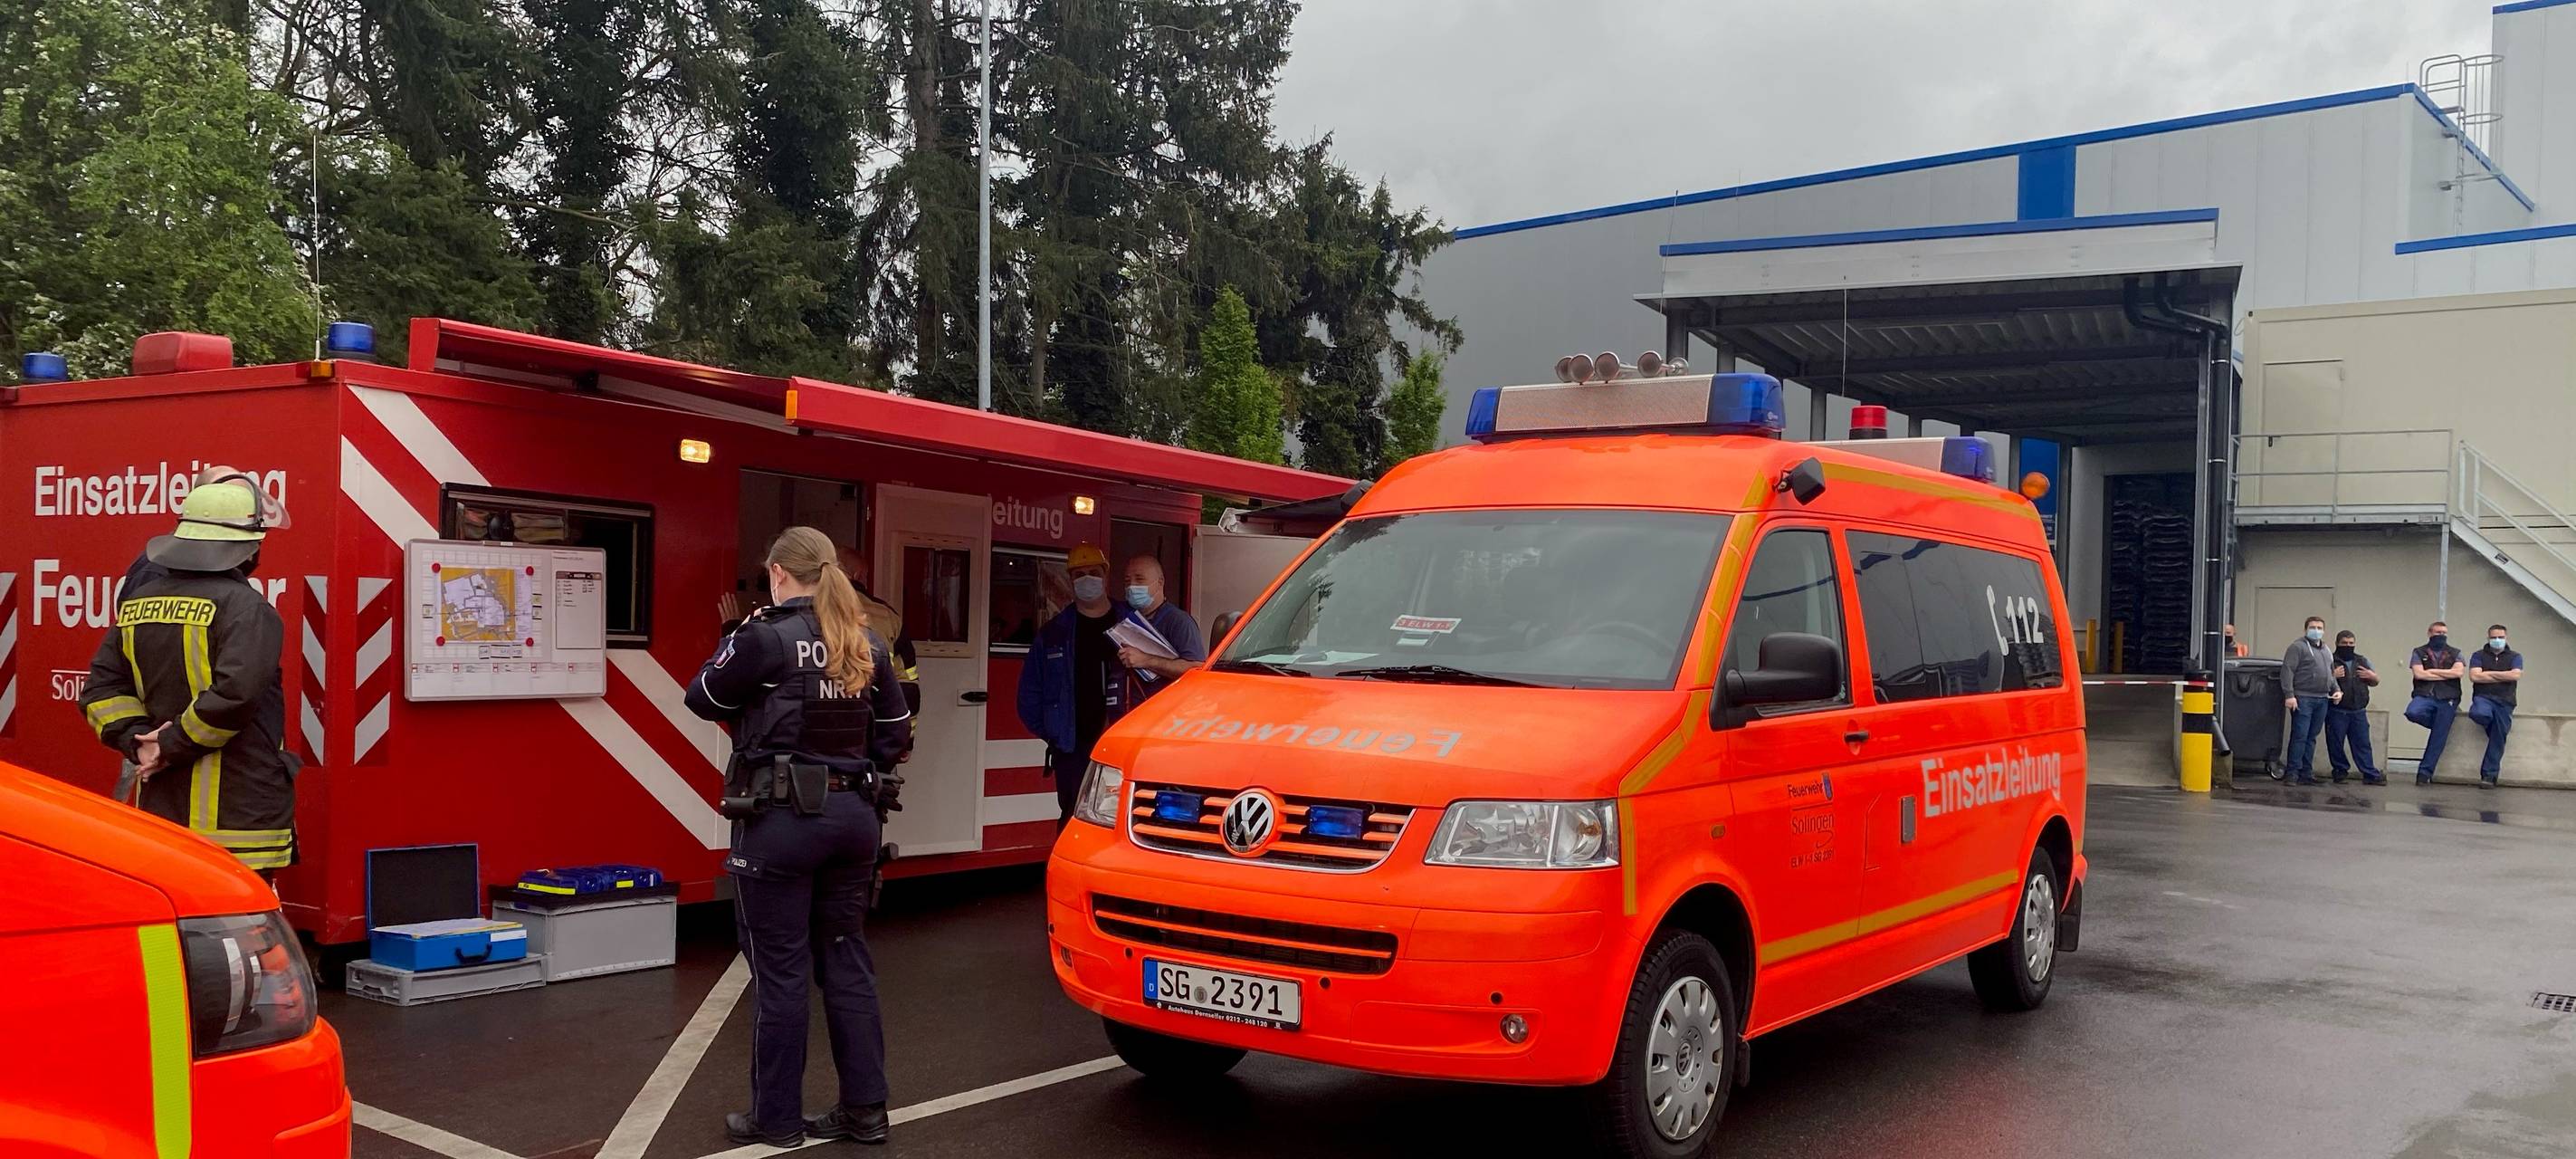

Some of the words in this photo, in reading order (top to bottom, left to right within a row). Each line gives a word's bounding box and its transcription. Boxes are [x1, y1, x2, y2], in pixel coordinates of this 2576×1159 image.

[35, 461, 286, 527] Einsatzleg
[993, 496, 1064, 539] eitung
[121, 599, 214, 623] FEUERWEHR
[1407, 620, 1435, 628] ELW
[2006, 596, 2044, 644] 112
[796, 641, 827, 668] PO
[52, 674, 85, 701] Soli
[819, 679, 861, 699] NR
[1787, 781, 1824, 798] Feuerwehr
[1921, 745, 2060, 819] Einsatzleitung
[1792, 812, 1833, 848] Solingen
[1149, 982, 1155, 992] D
[1160, 967, 1190, 1001] SG
[1211, 975, 1283, 1016] 2391
[1168, 1005, 1194, 1015] Autohaus
[1226, 1014, 1241, 1023] 0212
[1256, 1020, 1268, 1028] 120
